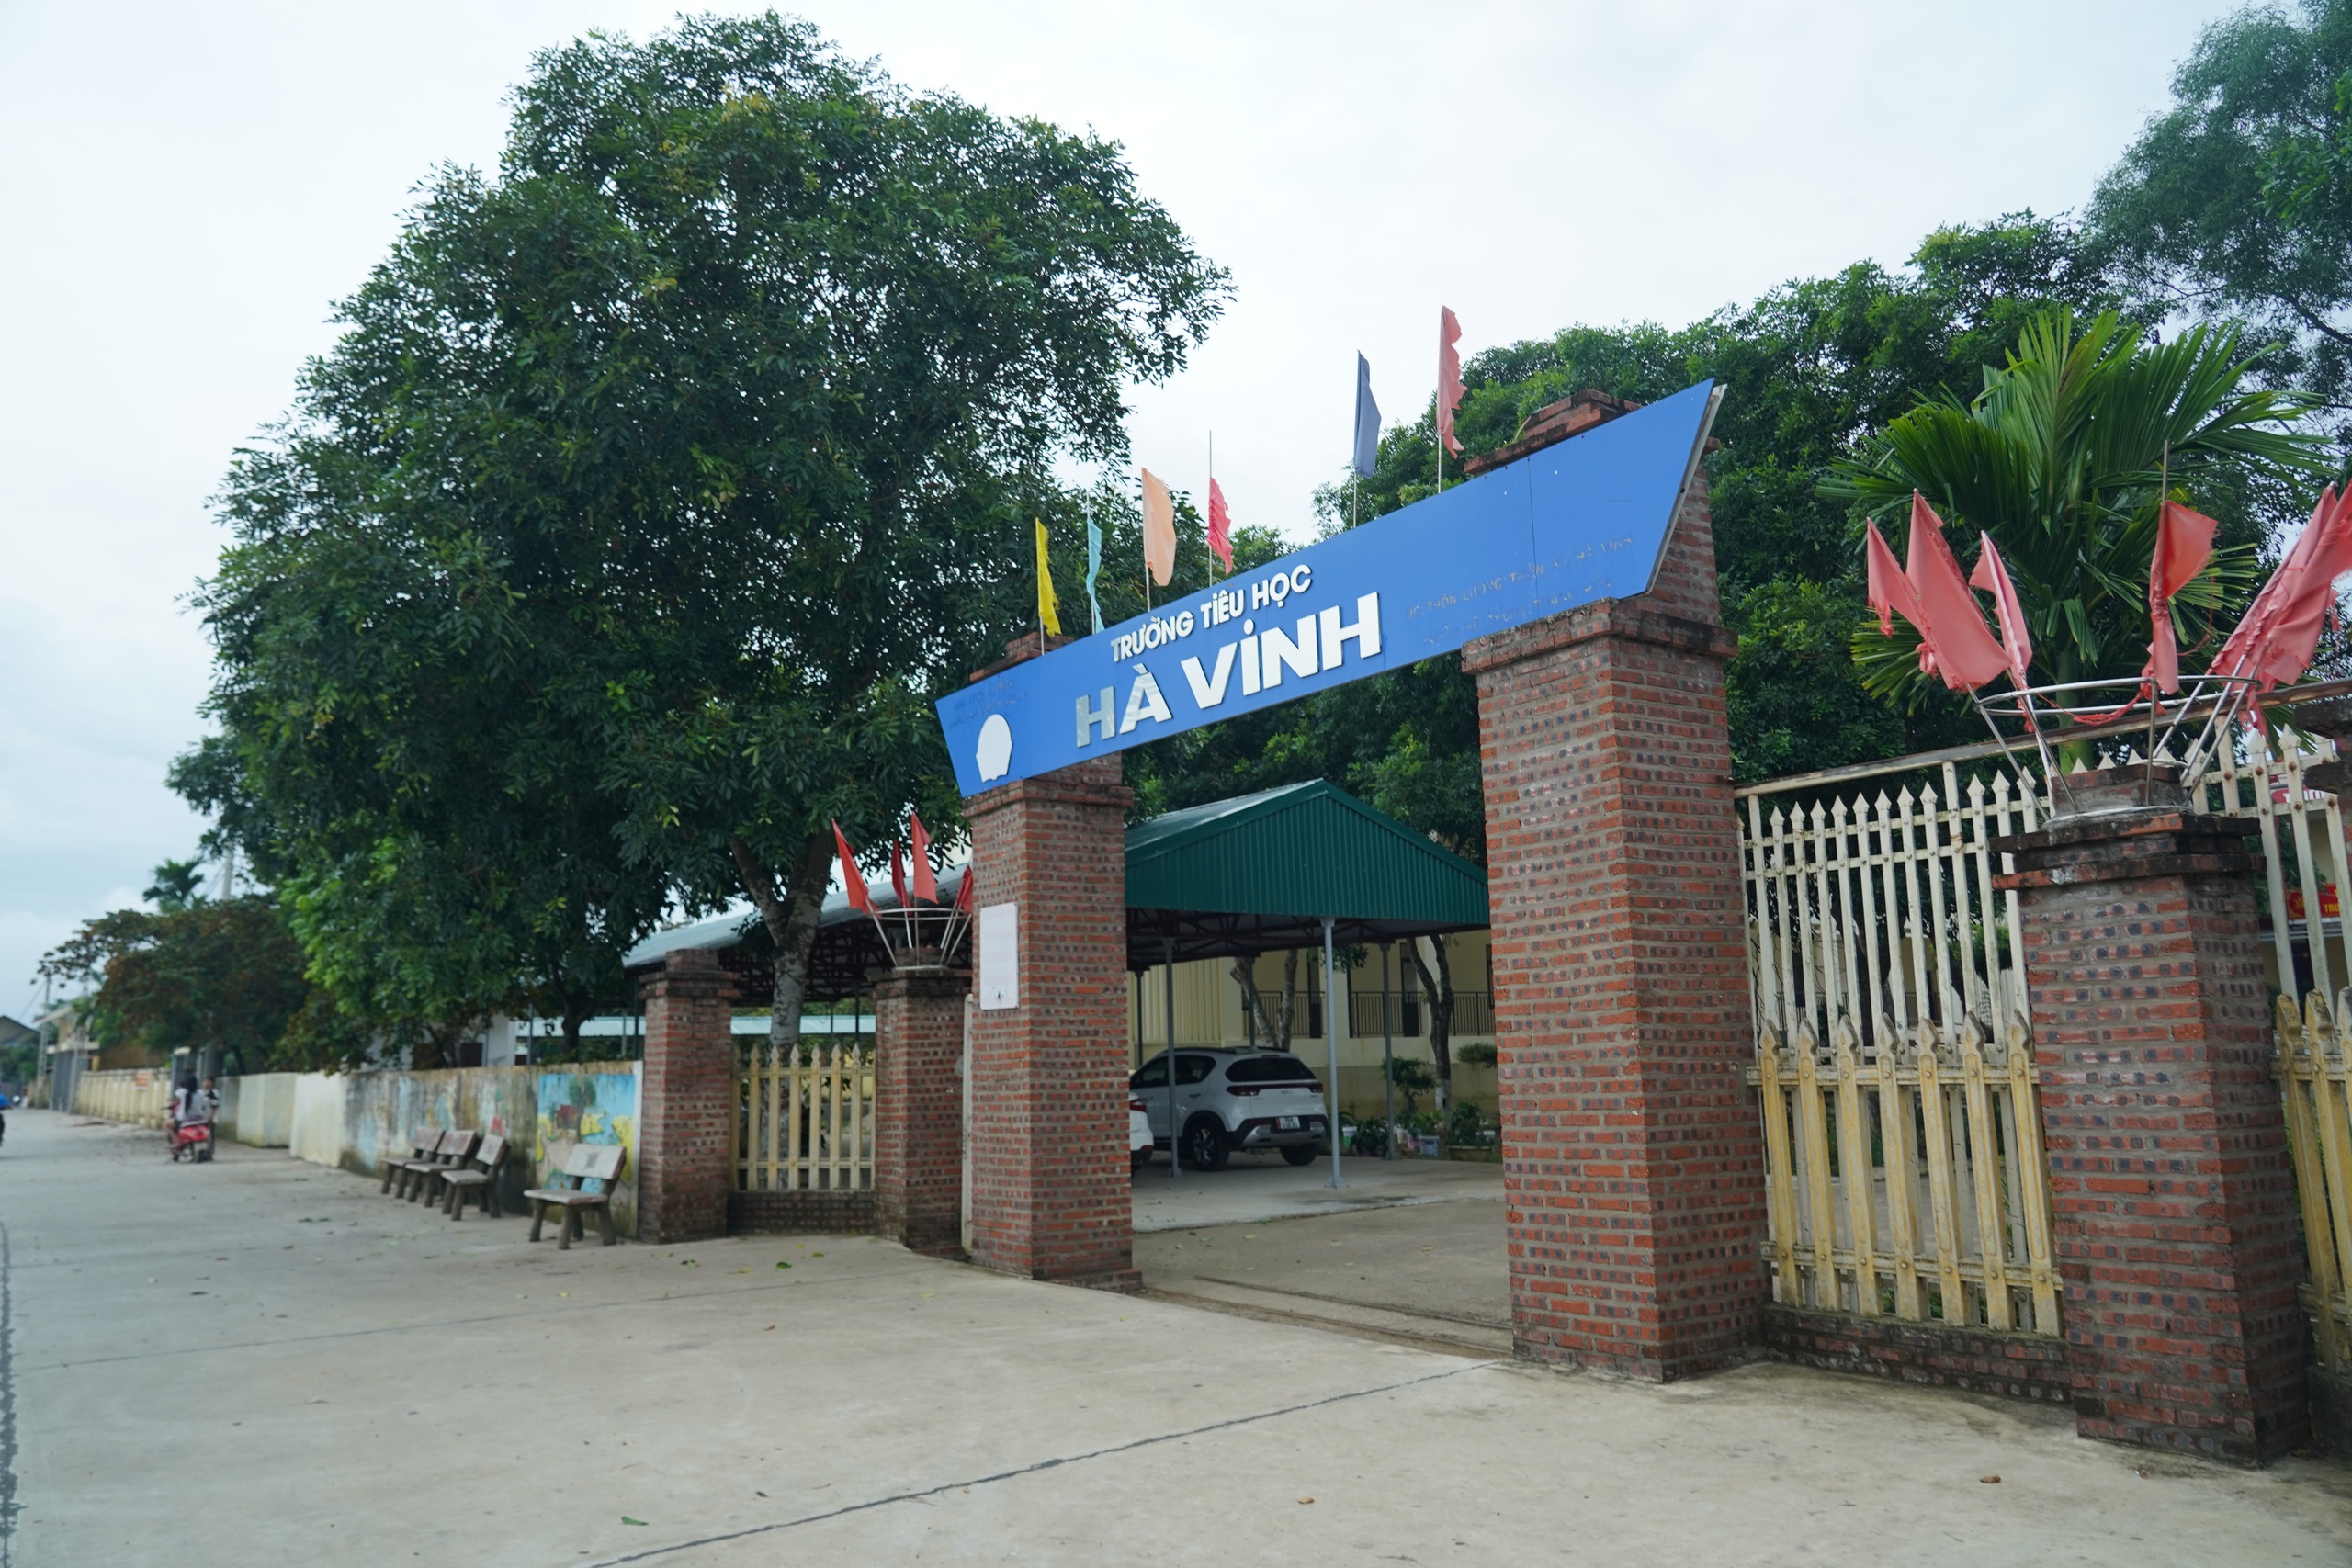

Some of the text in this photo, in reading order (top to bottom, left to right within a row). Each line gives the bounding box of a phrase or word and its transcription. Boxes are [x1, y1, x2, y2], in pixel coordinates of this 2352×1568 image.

[1110, 610, 1195, 662] TRƯỜNG
[1251, 564, 1312, 610] HỌC
[1075, 662, 1172, 748] HÀ
